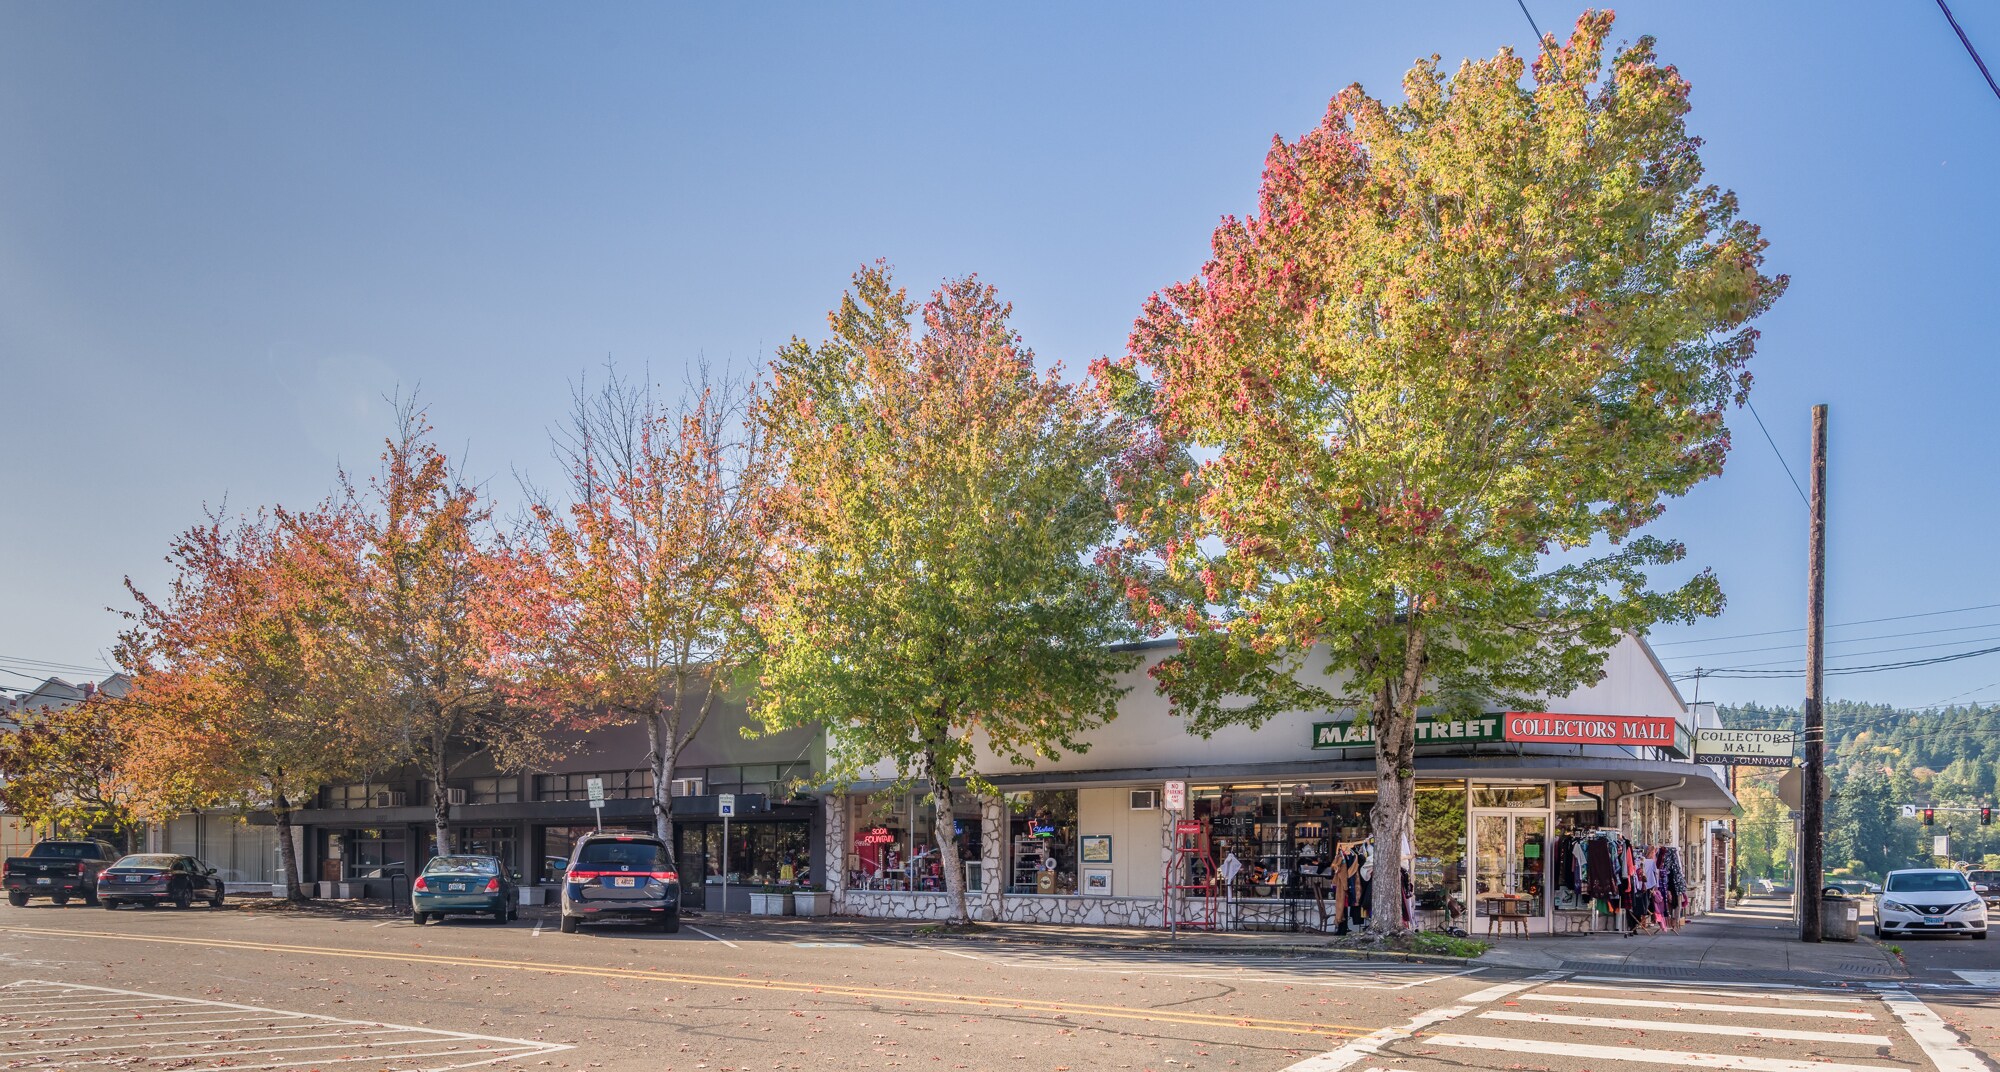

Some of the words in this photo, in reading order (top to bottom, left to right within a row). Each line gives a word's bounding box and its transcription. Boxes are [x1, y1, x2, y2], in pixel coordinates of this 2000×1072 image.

[1415, 719, 1497, 739] TREET
[1511, 718, 1616, 739] COLLECTORS
[1622, 721, 1670, 740] MALL
[1701, 731, 1791, 743] COLLECTORS
[1723, 743, 1765, 753] MALL
[1699, 755, 1728, 764] SODA
[1222, 817, 1244, 826] DELI
[871, 827, 888, 835] SODA
[864, 835, 895, 844] FOUNTAIN
